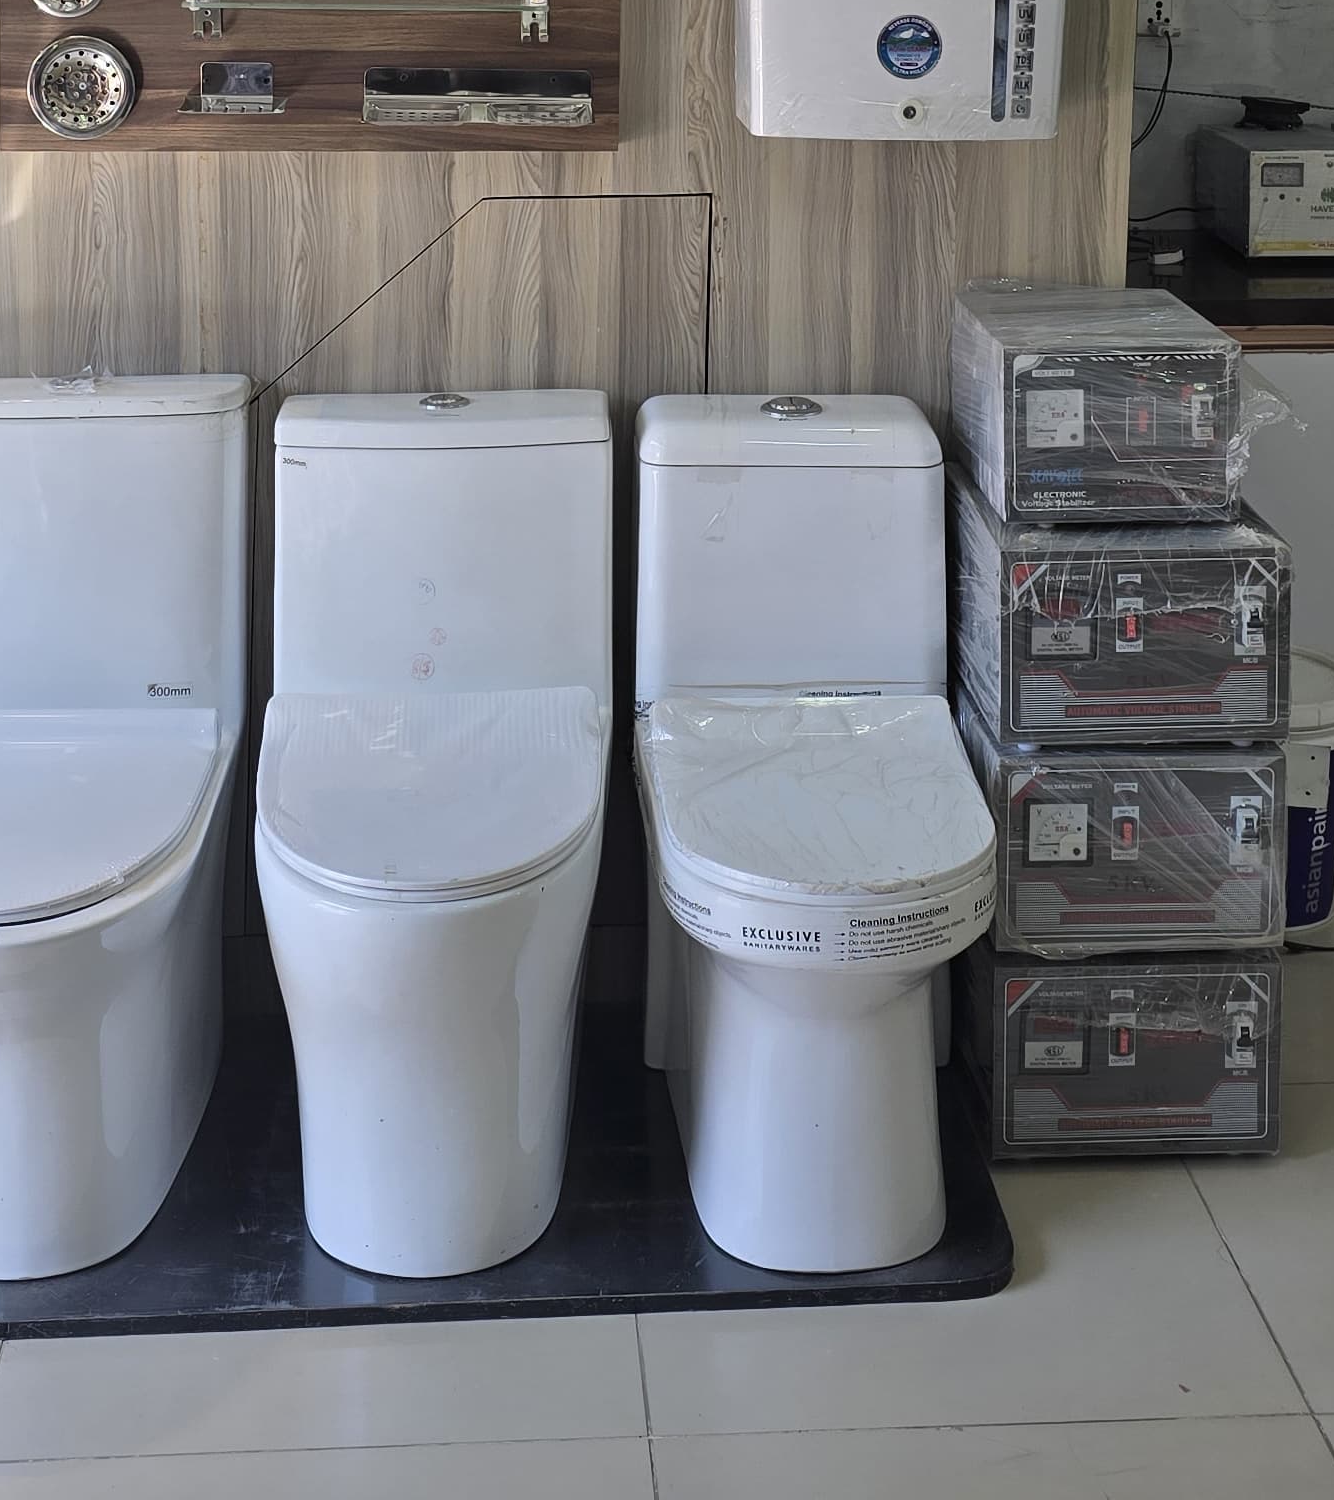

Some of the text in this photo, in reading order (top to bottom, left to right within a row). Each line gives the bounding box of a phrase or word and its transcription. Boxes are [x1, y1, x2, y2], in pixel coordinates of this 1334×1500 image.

[1033, 491, 1087, 499] ELECTRONIC
[149, 686, 191, 697] 300mm
[1302, 806, 1331, 914] asianpai
[849, 904, 950, 928] Cleaning Instructions
[742, 926, 822, 943] EXCLUSIVE
[743, 941, 822, 953] SANITARYWARES
